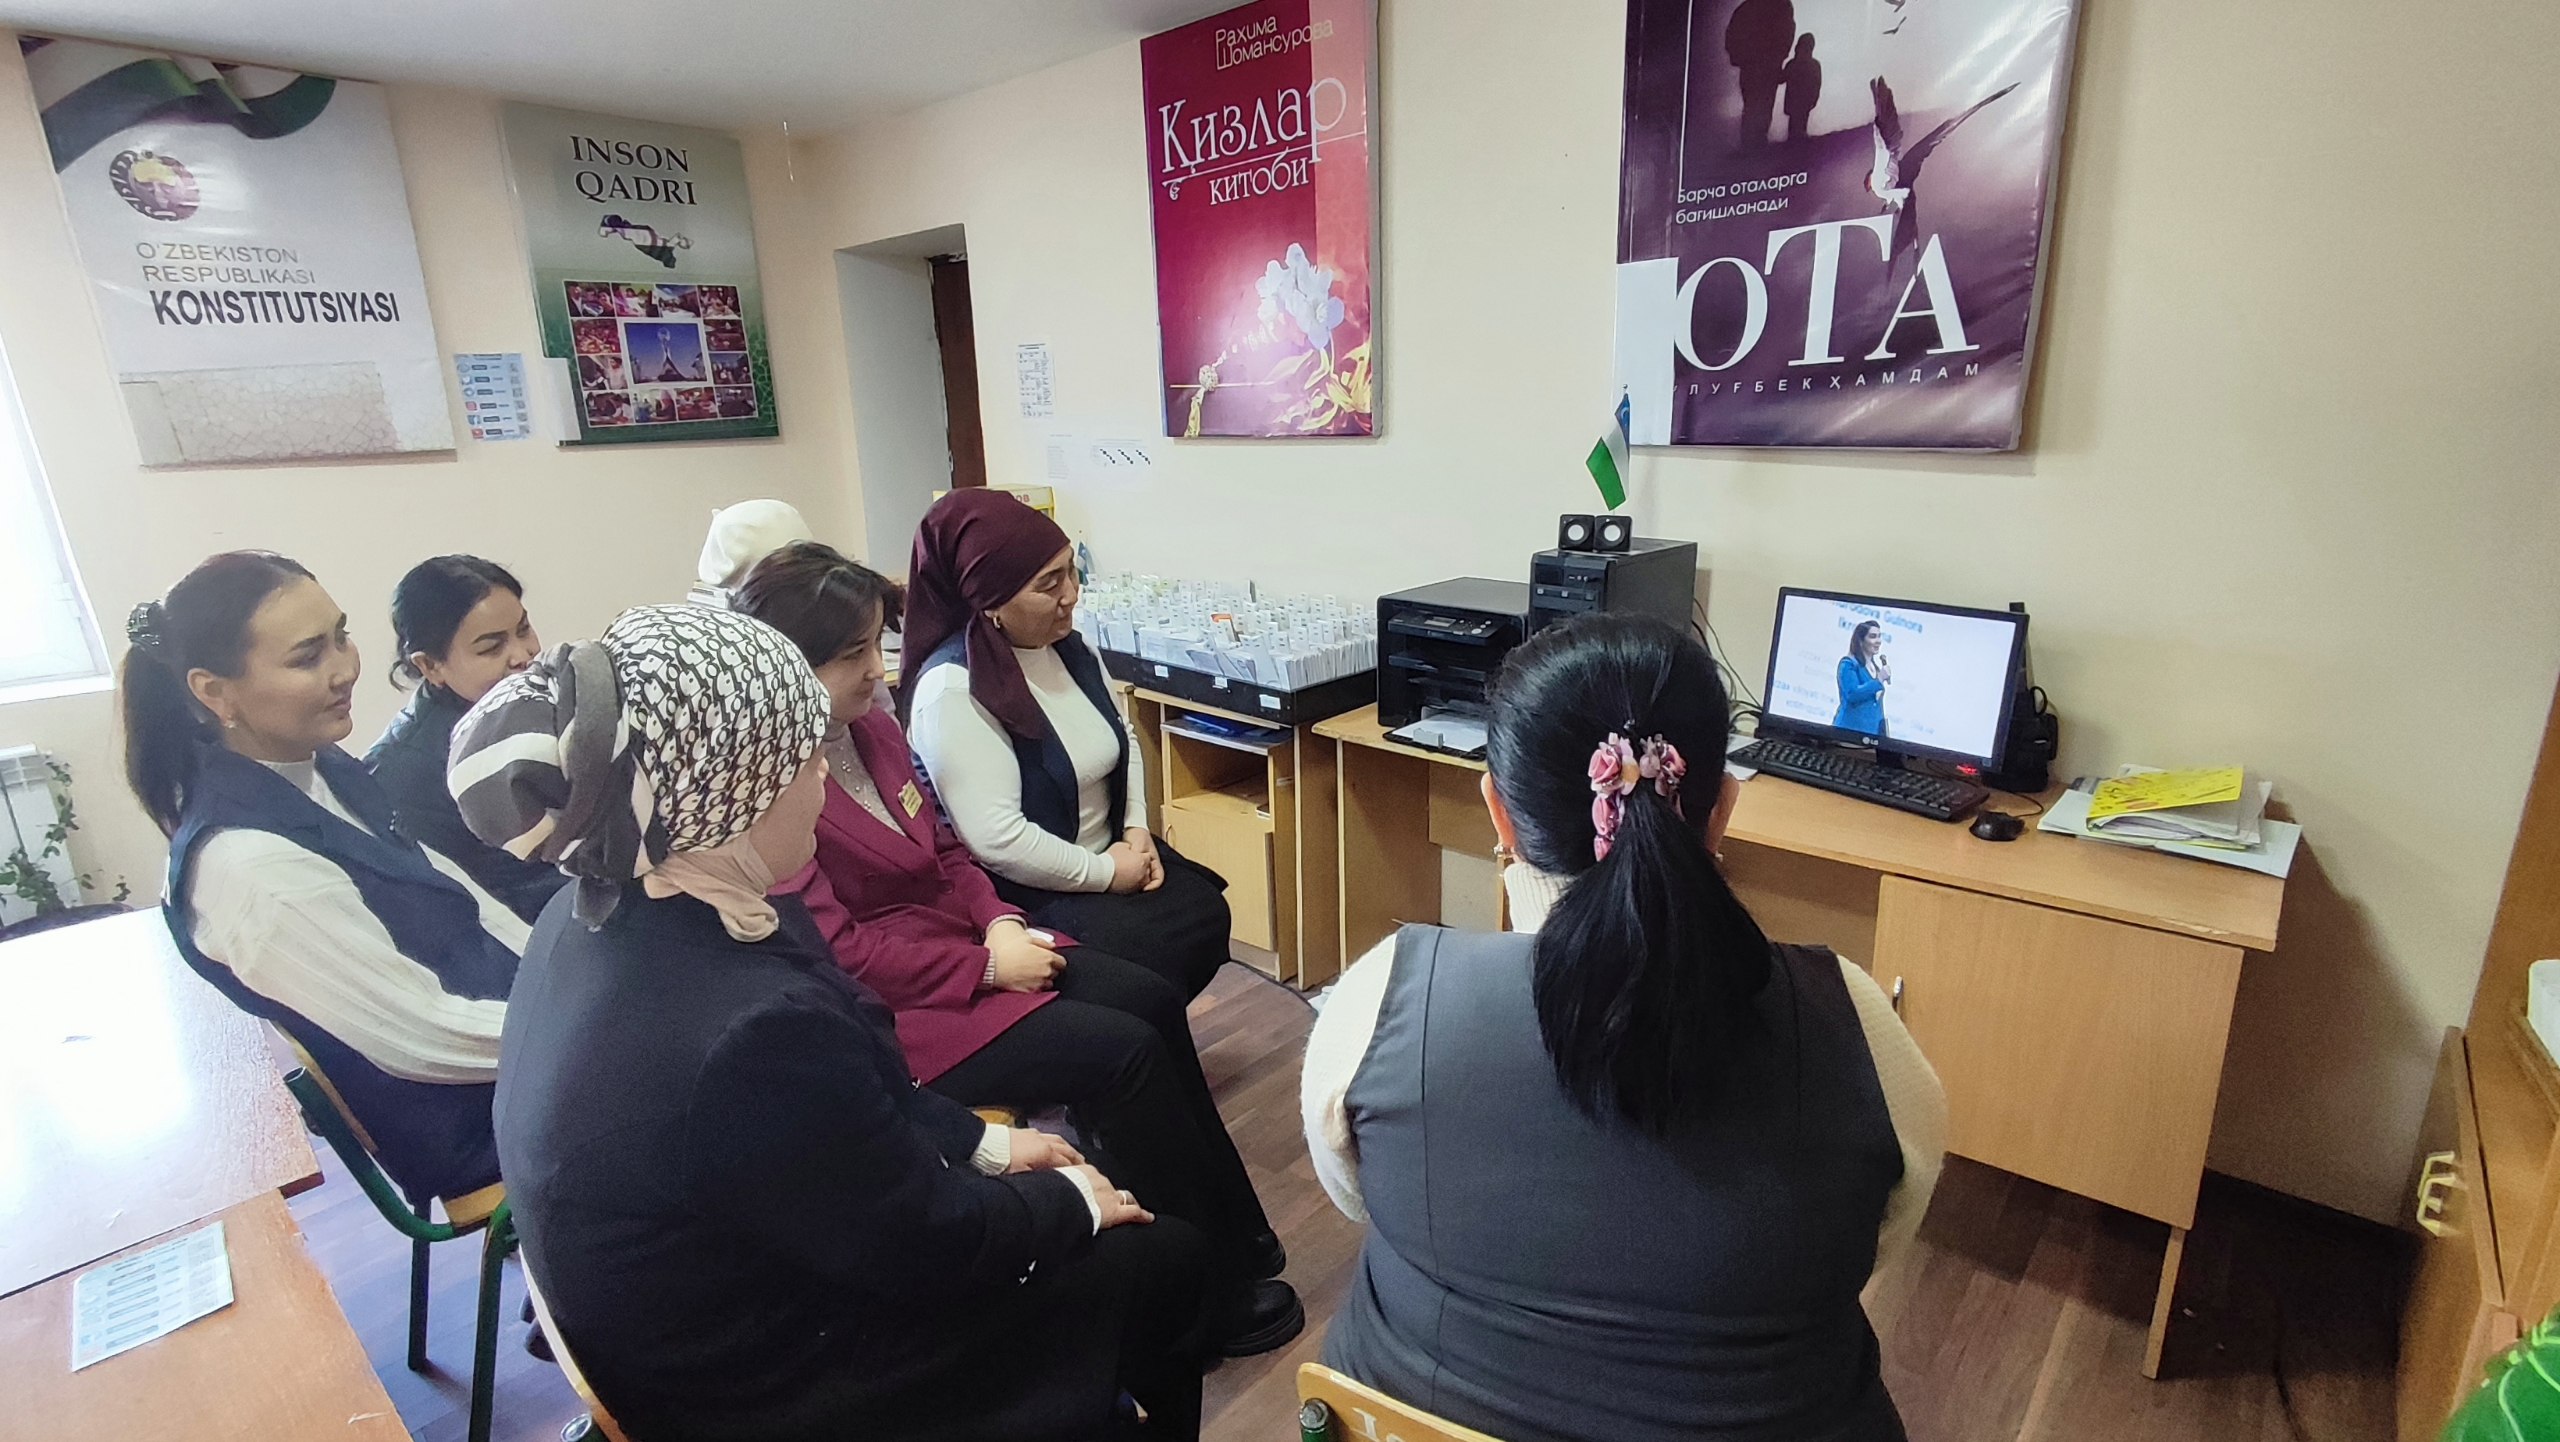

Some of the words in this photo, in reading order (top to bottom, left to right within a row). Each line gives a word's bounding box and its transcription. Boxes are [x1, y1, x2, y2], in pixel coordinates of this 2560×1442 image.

[1215, 15, 1278, 47] Рахима
[1215, 19, 1334, 70] Шомансурова
[569, 135, 689, 173] INSON
[575, 170, 698, 206] QADRI
[1677, 185, 1726, 205] Барча
[1729, 171, 1808, 196] оталарга
[135, 242, 299, 264] O'ZBEKISTON
[142, 264, 316, 285] RESPUBLIKASI
[149, 289, 401, 326] KONSTITUTSIYASI
